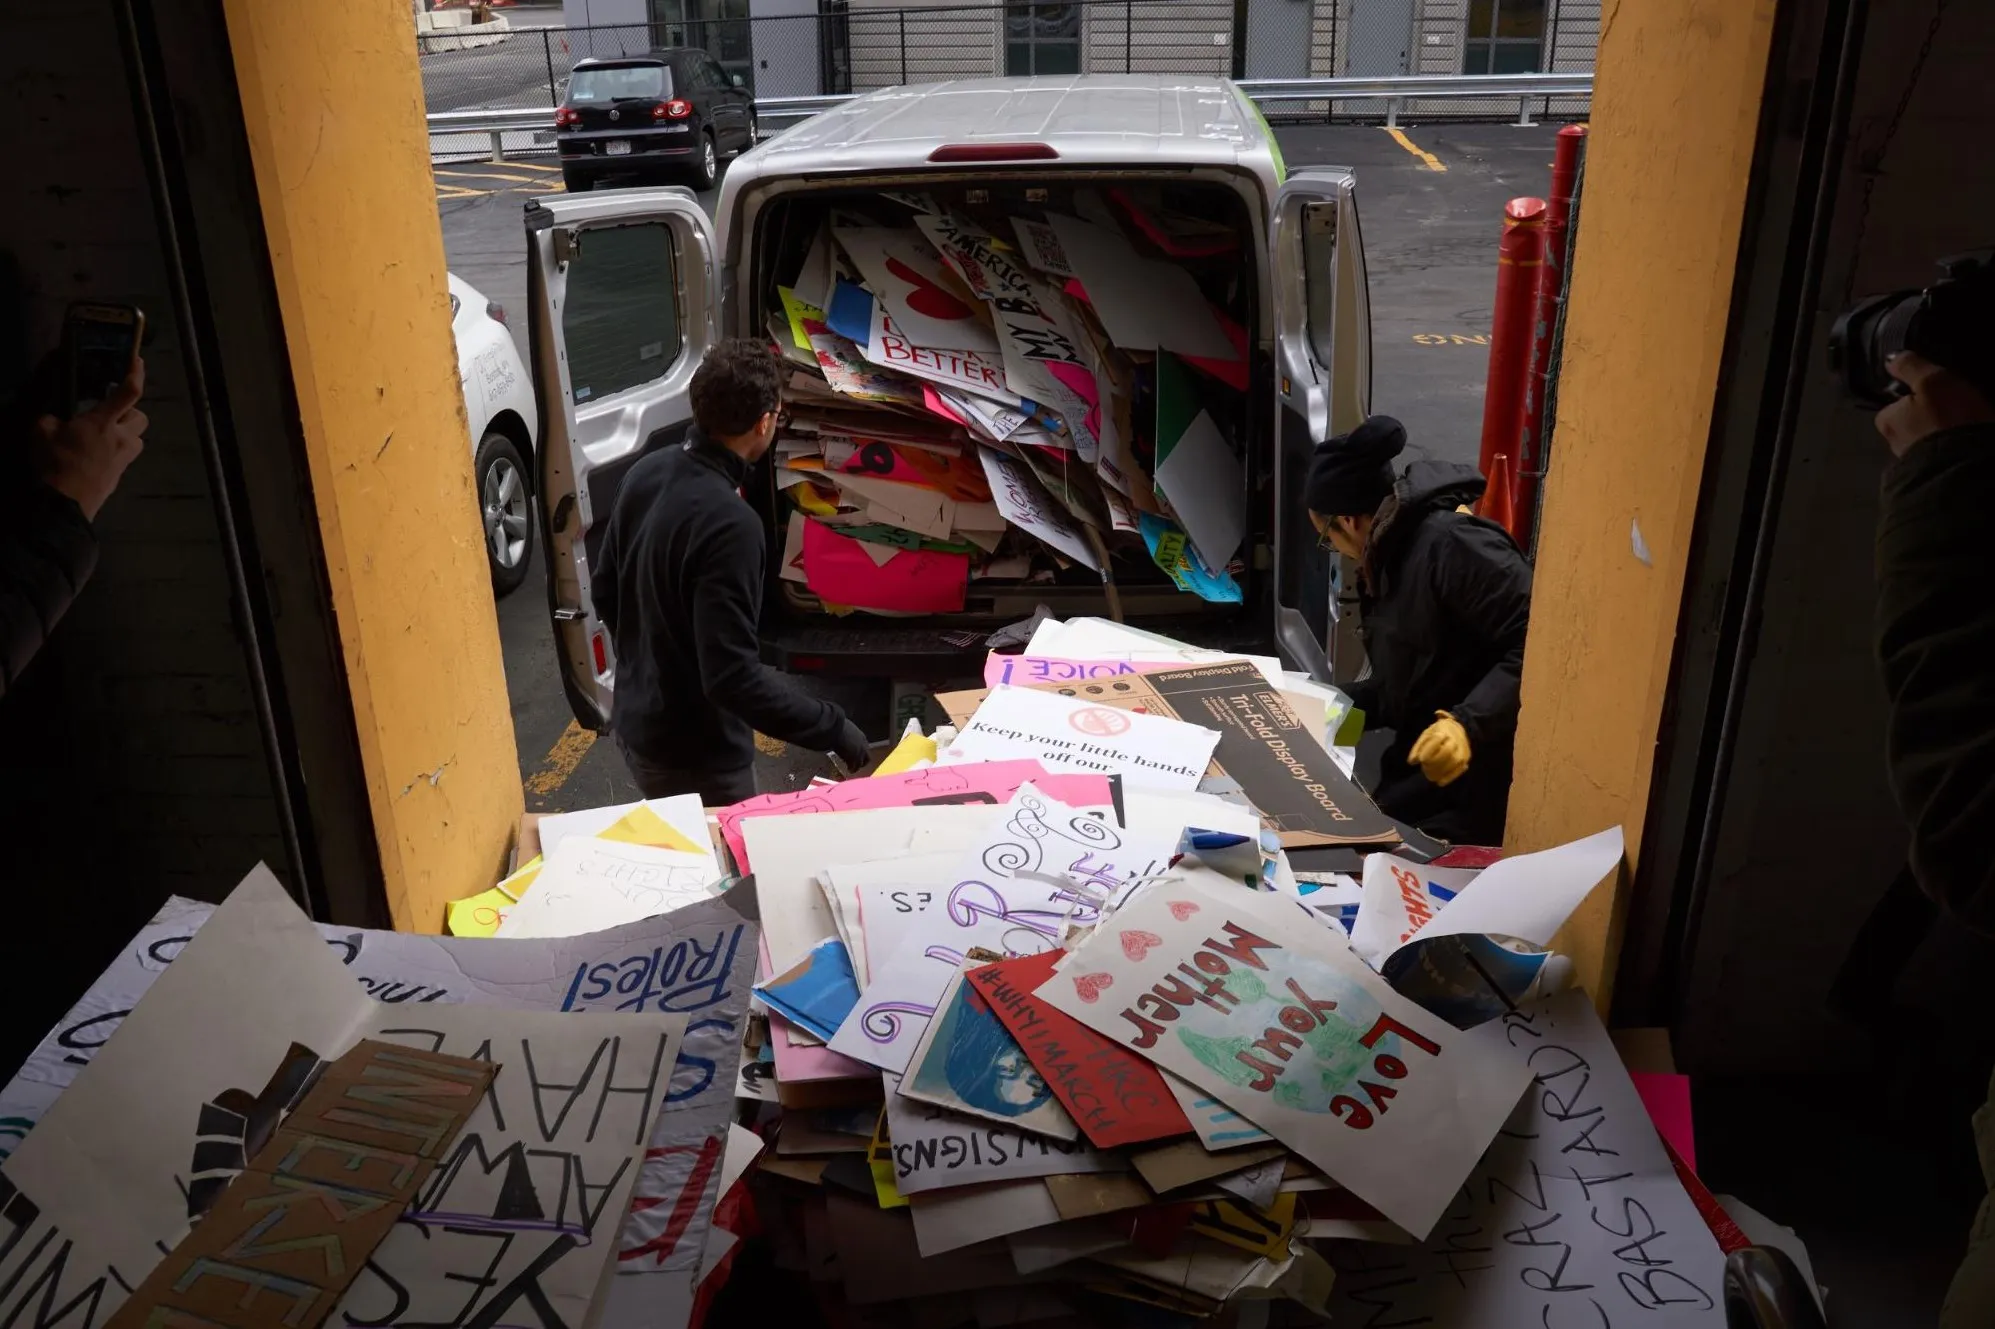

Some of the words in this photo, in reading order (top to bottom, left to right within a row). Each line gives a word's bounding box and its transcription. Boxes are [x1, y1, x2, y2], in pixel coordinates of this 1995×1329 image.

[882, 337, 1000, 389] BETTER
[1159, 671, 1193, 681] Board
[1193, 666, 1230, 677] Display
[972, 721, 1023, 740] Keep
[1023, 733, 1077, 752] your
[1079, 741, 1130, 762] little
[1133, 754, 1198, 777] hands
[1042, 751, 1074, 765] off
[1075, 757, 1115, 772] our
[1229, 693, 1274, 739] Tri-Fold
[1266, 739, 1314, 783] Display
[1303, 782, 1354, 822] Board
[1119, 919, 1282, 1050] Mother
[1328, 1012, 1442, 1131] Love
